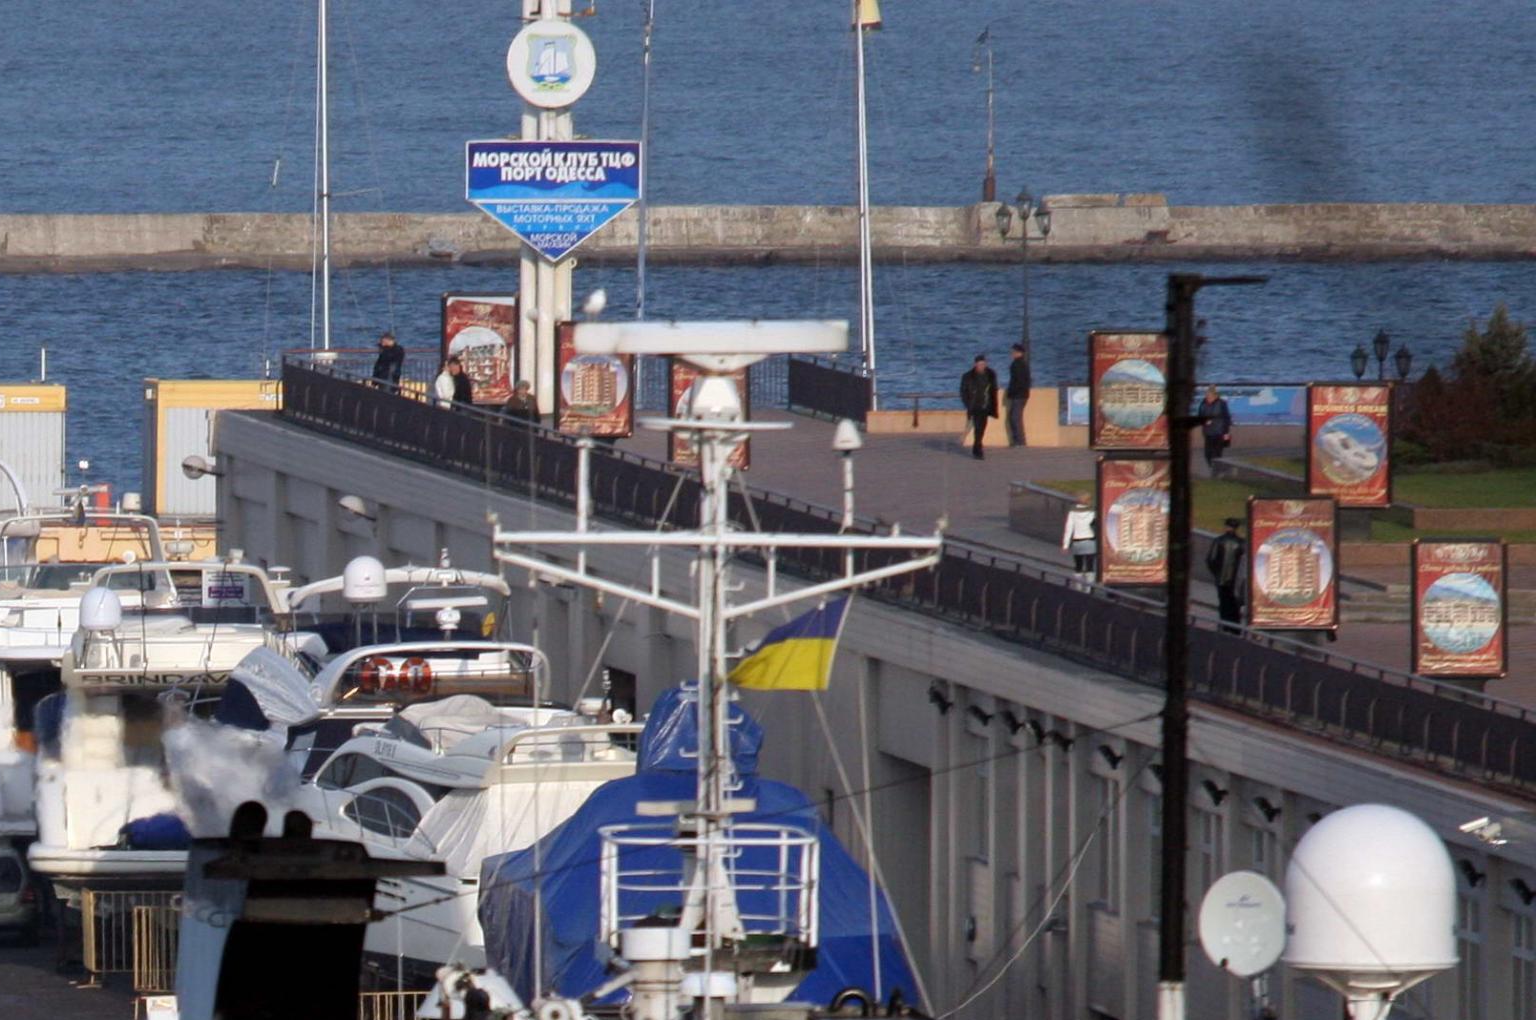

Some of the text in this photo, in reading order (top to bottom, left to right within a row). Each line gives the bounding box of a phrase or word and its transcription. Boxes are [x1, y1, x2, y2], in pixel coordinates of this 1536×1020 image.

[473, 149, 552, 168] МОРСКОЙ
[554, 152, 598, 168] КЛУБ
[501, 167, 606, 183] ПОРТ ОДЕССА
[496, 204, 609, 214] ВЫСТАВКА-ПРОДАЖА
[513, 214, 596, 223] МОТОРНЫХ ЯХТ
[530, 232, 578, 242] МОРСКОЙ
